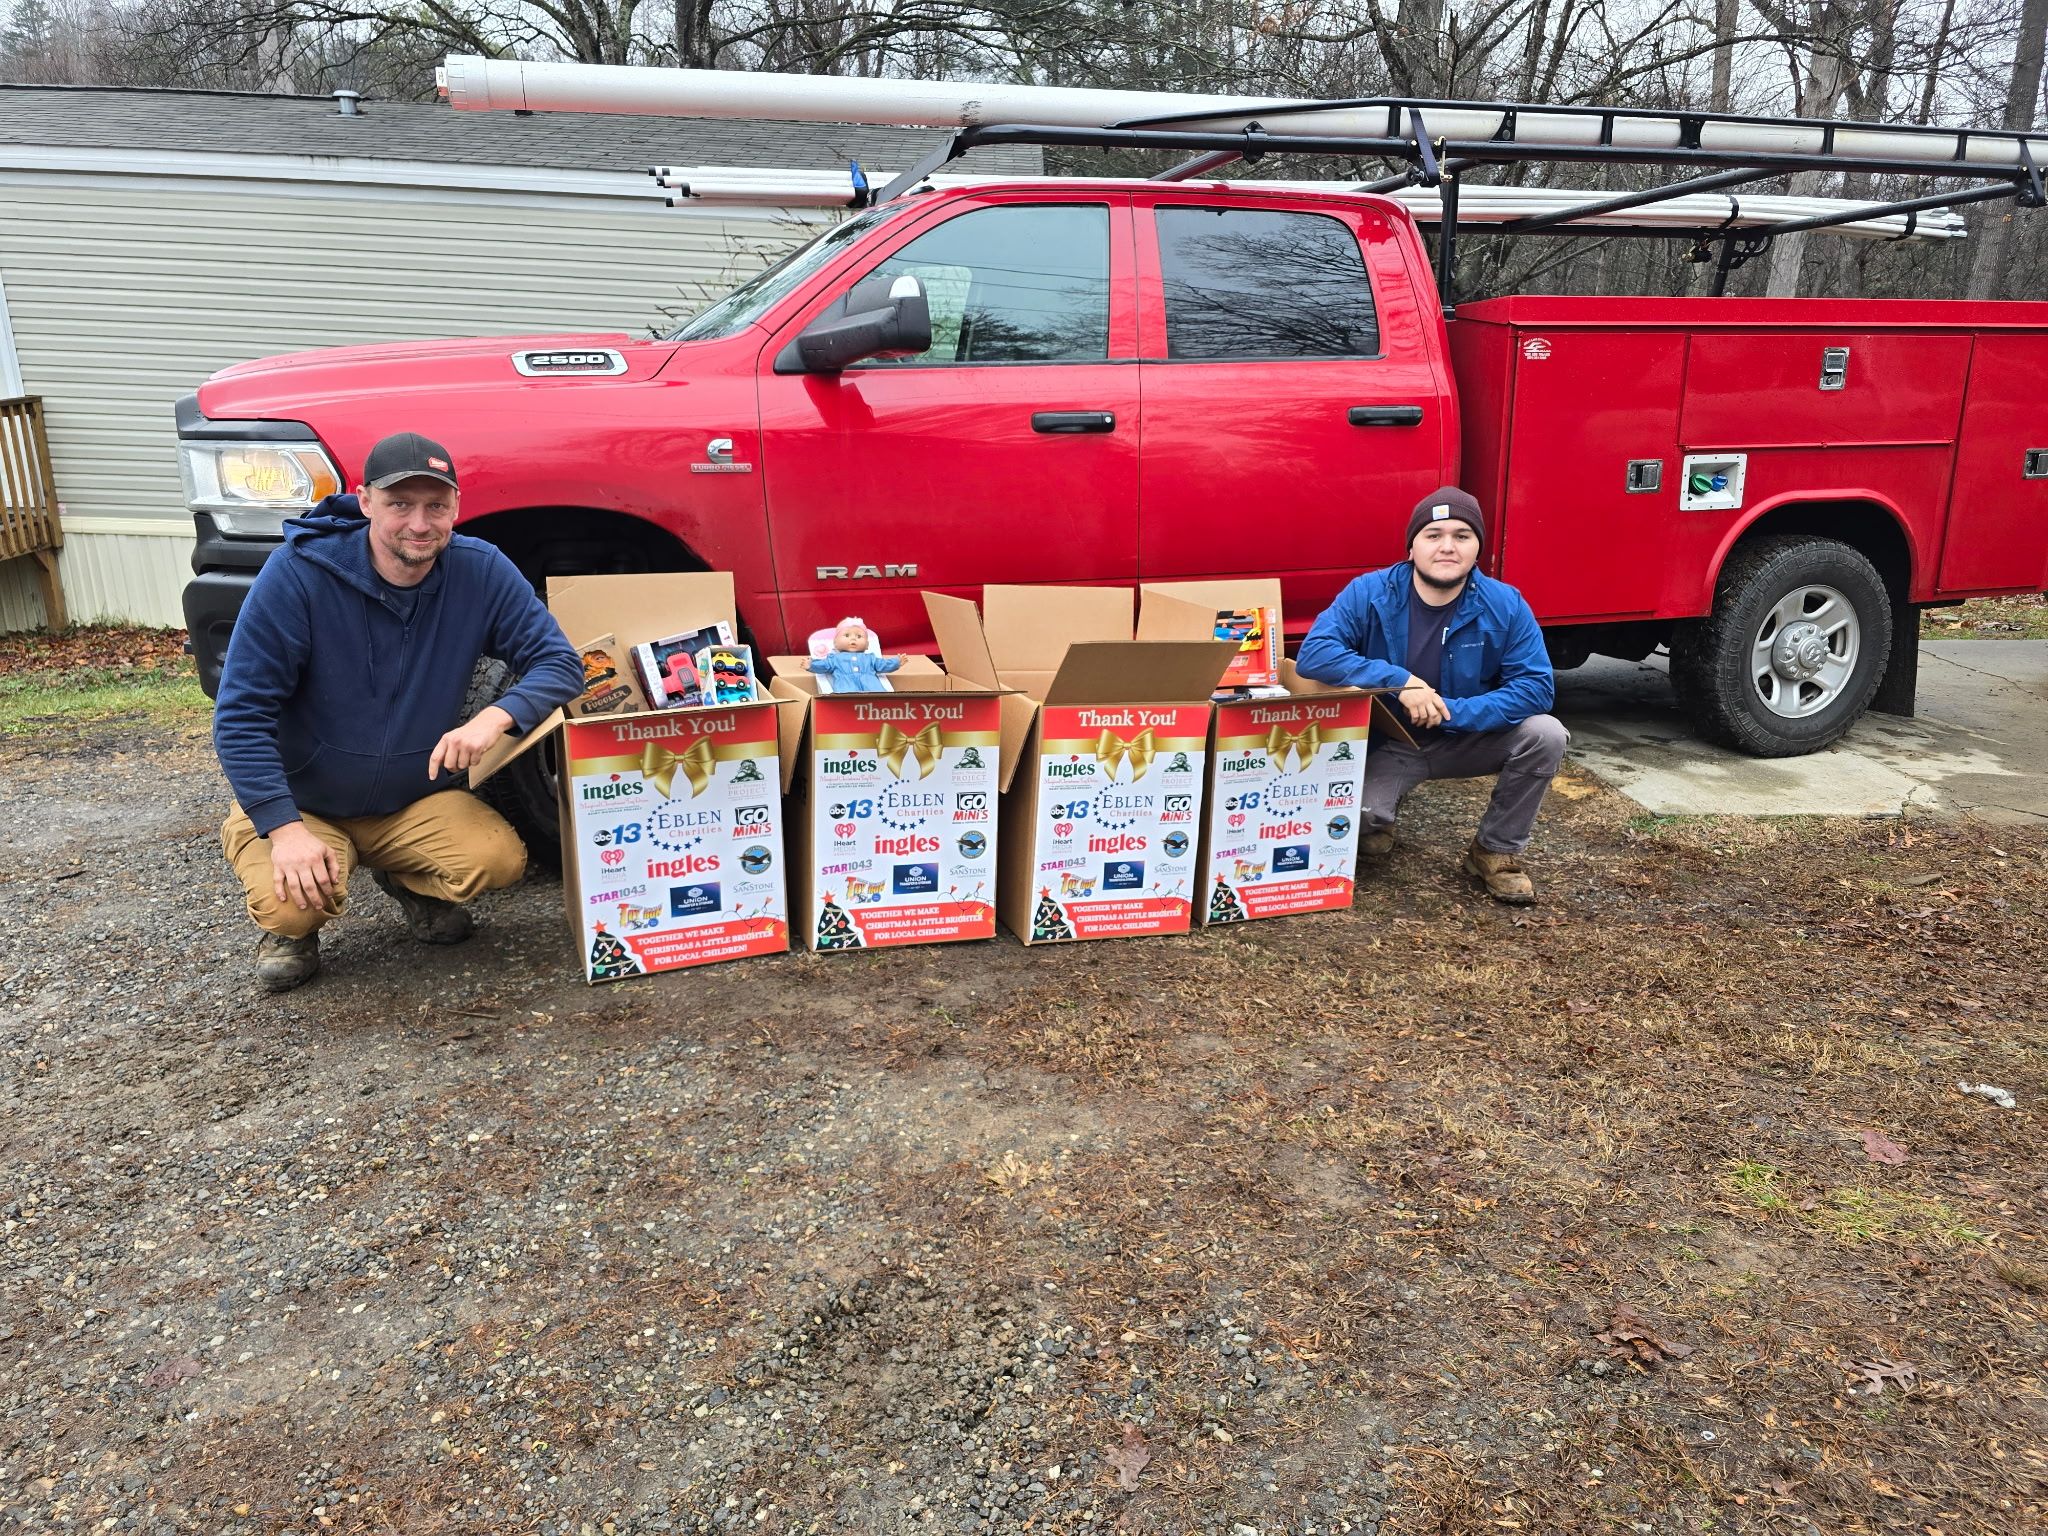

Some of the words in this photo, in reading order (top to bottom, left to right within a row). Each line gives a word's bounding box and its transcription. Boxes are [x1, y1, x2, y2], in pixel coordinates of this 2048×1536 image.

[532, 354, 605, 365] 2500
[816, 564, 918, 580] RAM
[854, 703, 918, 721] Thank
[921, 702, 964, 720] You!
[1078, 710, 1134, 726] Thank
[1138, 710, 1177, 726] You!
[1250, 706, 1300, 724] Thank
[1306, 704, 1340, 719] You!
[613, 718, 684, 742] Thank
[692, 714, 736, 735] You!
[824, 758, 877, 776] ingles
[1048, 762, 1096, 778] ingles
[1223, 758, 1266, 772] ingles
[952, 774, 986, 782] PROJECT
[583, 782, 644, 800] ingles
[1272, 784, 1318, 798] EBLEN
[1331, 782, 1353, 798] GO
[888, 792, 944, 808] EBLEN
[961, 795, 986, 810] GO
[1103, 794, 1154, 809] EBLEN
[1168, 796, 1190, 811] GO
[1225, 800, 1238, 808] abc
[1239, 792, 1260, 810] 13
[1278, 798, 1318, 806] Charities
[740, 808, 768, 825] GO
[830, 804, 846, 815] abc
[847, 800, 874, 819] 13
[897, 808, 944, 818] Charities
[1050, 806, 1065, 816] abc
[1066, 800, 1090, 820] 13
[1110, 808, 1152, 818] Charities
[659, 810, 722, 829] EBLEN
[594, 834, 612, 842] abc
[612, 823, 642, 844] 13
[669, 826, 722, 838] Charities
[1258, 820, 1312, 840] ingles
[875, 834, 940, 856] ingles
[1088, 834, 1147, 854] ingles
[601, 866, 626, 874] iHeart
[648, 854, 720, 878] ingles
[684, 896, 708, 904] UNION
[860, 909, 902, 920] TOGETHER
[904, 908, 916, 916] WE
[917, 907, 940, 915] MAKE
[866, 920, 910, 930] CHRISTMAS
[918, 916, 945, 926] LITTLE
[946, 914, 984, 924] BRIGHTER
[637, 932, 684, 946] TOGETHER
[685, 930, 700, 938] WE
[700, 926, 725, 936] MAKE
[874, 932, 890, 940] FOR
[891, 930, 916, 938] LOCAL
[918, 926, 959, 936] CHILDREN!
[644, 942, 694, 956] CHRISTMAS
[702, 936, 731, 947] LITTLE
[732, 930, 774, 942] BRIGHTER
[654, 956, 673, 966] FOR
[674, 952, 701, 963] LOCAL
[702, 944, 748, 957] CHILDREN!
